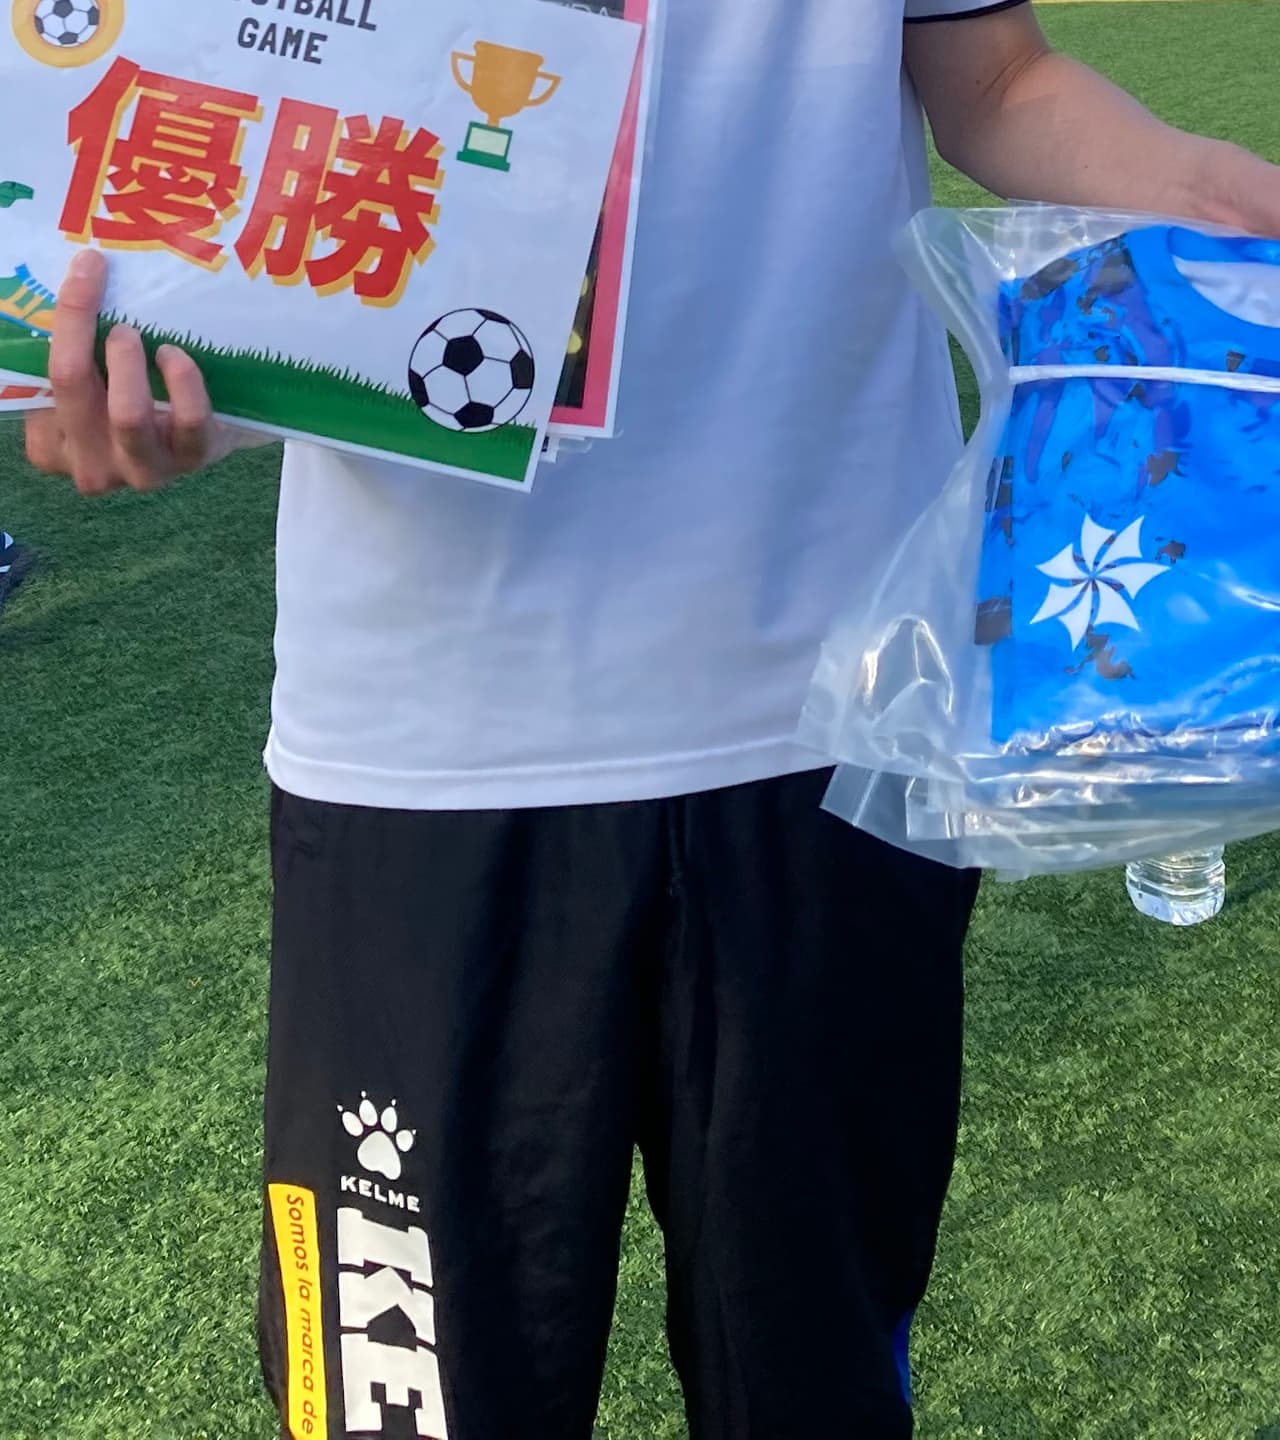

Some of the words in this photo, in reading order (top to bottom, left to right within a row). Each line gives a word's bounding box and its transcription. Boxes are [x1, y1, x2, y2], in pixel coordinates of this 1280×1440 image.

[237, 17, 328, 65] GAME
[58, 55, 446, 308] 優勝
[340, 1175, 420, 1213] KELME
[286, 1193, 310, 1272] Somos
[298, 1278, 314, 1301] la
[299, 1307, 316, 1391] marca
[301, 1400, 317, 1435] de
